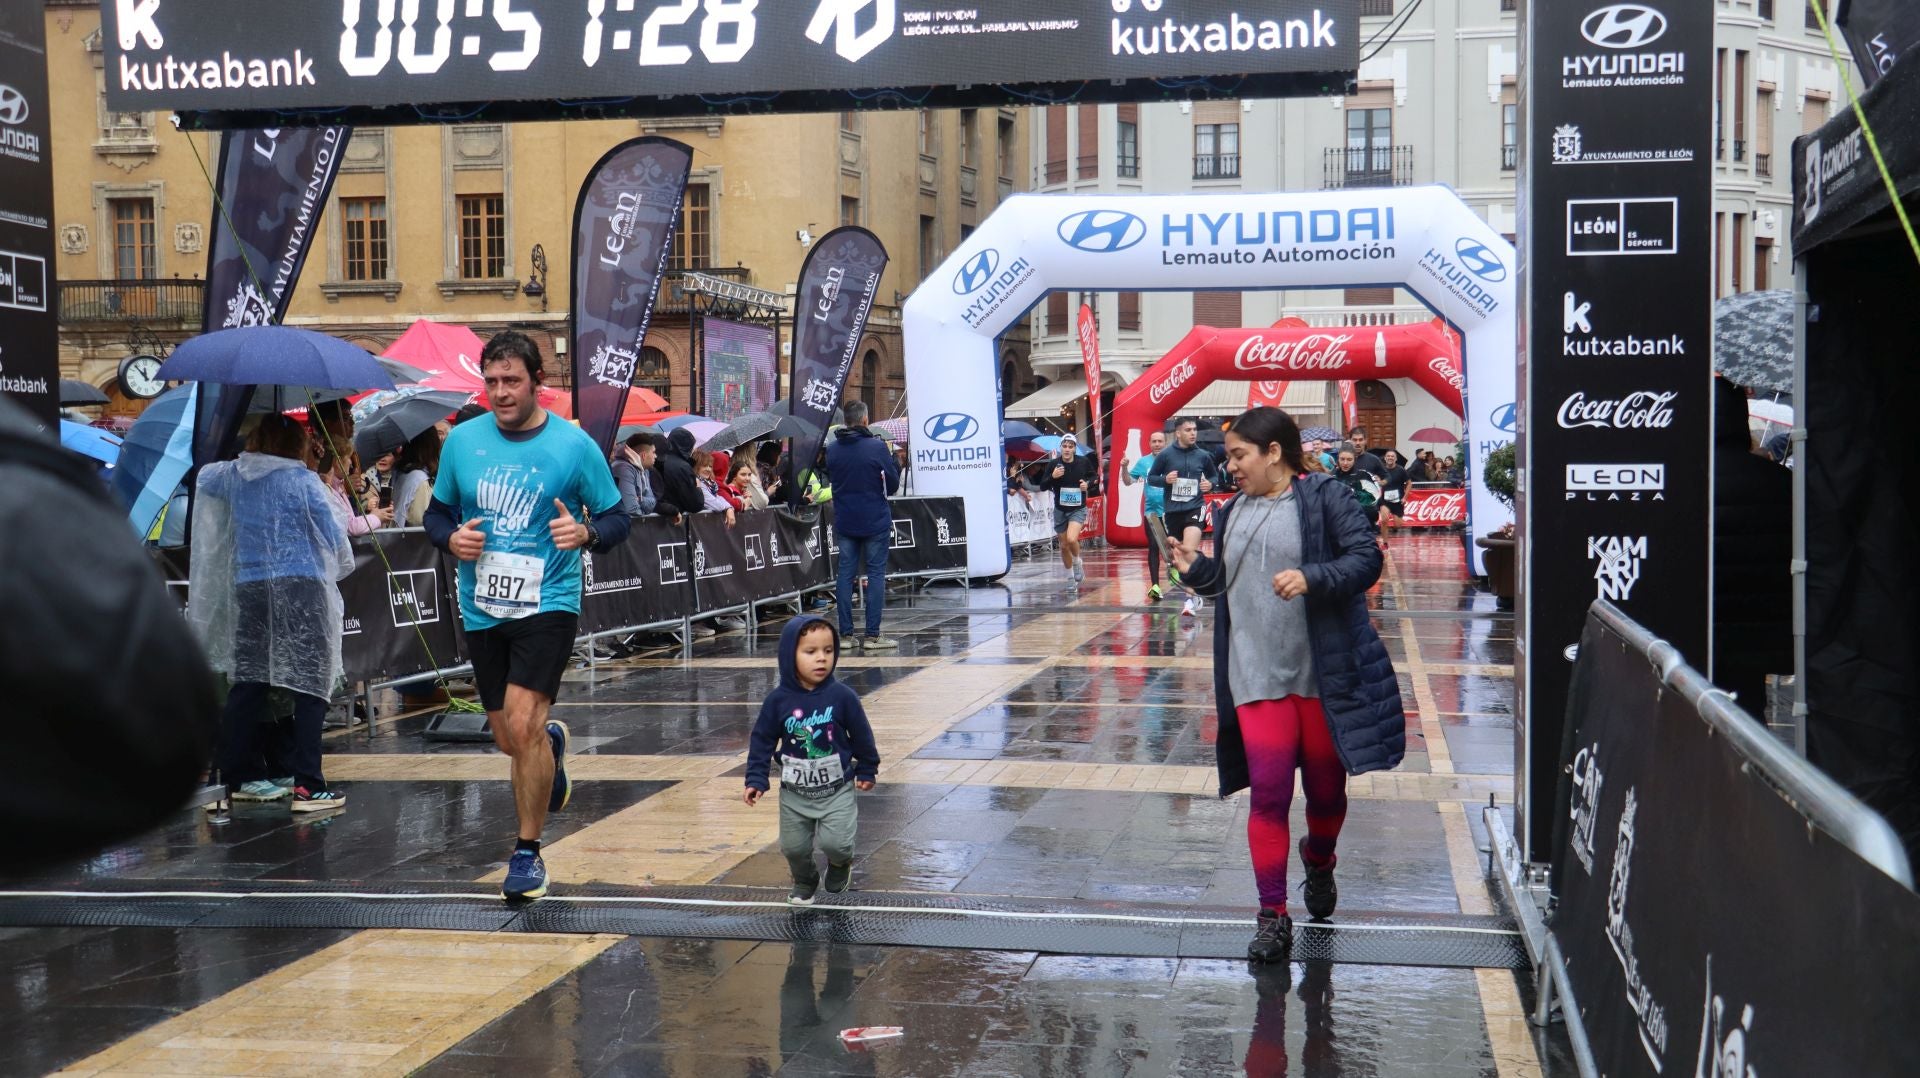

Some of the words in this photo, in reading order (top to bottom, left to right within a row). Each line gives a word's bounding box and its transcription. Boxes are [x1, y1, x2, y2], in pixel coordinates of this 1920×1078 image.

[1111, 9, 1336, 55] kutxabank
[120, 49, 316, 90] kutxabank
[1562, 53, 1685, 76] HYUNDAI
[1562, 78, 1611, 88] Lemauto
[1614, 75, 1684, 86] Automoción
[1582, 151, 1652, 161] AYUNTAMIENTO
[1655, 150, 1667, 159] DE
[1669, 148, 1693, 157] LEÓN
[272, 151, 330, 299] AYUNTAMIENTO
[1162, 207, 1395, 247] HYUNDAI
[1573, 216, 1617, 235] LEÓN
[1162, 250, 1256, 266] Lemauto
[1262, 243, 1395, 263] Automoción
[1627, 239, 1662, 247] DEPORTE
[961, 257, 1029, 323] HYUNDAI
[1418, 259, 1447, 286] Lemauto
[1447, 284, 1487, 320] Automoción
[1424, 247, 1499, 313] HYUNDAI
[18, 294, 38, 304] DEPORTE
[972, 303, 999, 329] Lemauto
[1000, 267, 1036, 304] Automoción
[835, 313, 863, 384] AYUNTAMIENTO
[859, 297, 867, 311] DE
[864, 272, 876, 297] LEÓN
[1234, 334, 1354, 370] Coca-Cola
[1563, 334, 1685, 356] kutxabank
[1150, 356, 1195, 405] Coca-Cola
[1556, 391, 1679, 429] Coca-Cola
[917, 446, 991, 462] HYUNDAI
[947, 461, 991, 470] Automoción
[1571, 469, 1660, 484] LEON
[1565, 492, 1664, 501] PLAZA
[1587, 536, 1647, 559] KAM
[661, 556, 673, 569] LEÓN
[488, 574, 526, 600] 897
[1597, 578, 1637, 600] NY
[345, 616, 361, 630] LEÓN
[793, 768, 830, 787] 2146
